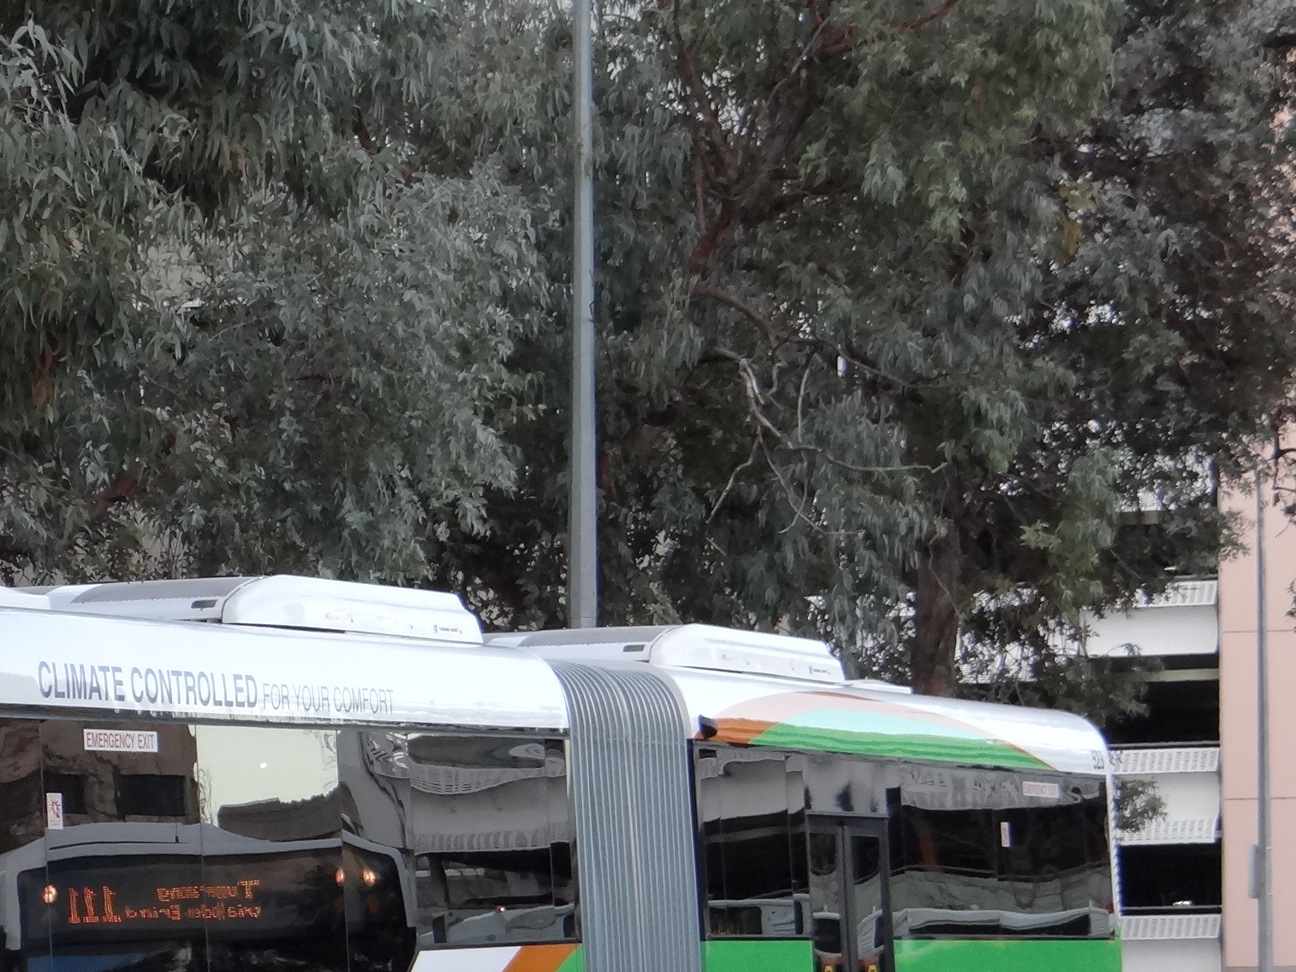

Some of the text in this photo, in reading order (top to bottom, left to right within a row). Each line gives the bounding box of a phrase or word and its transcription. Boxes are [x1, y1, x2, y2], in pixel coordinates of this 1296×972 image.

[37, 660, 394, 715] CLIMATE CONTROLLED FOR YOUR COMFORT
[85, 731, 155, 751] EMERGENCY EXIT
